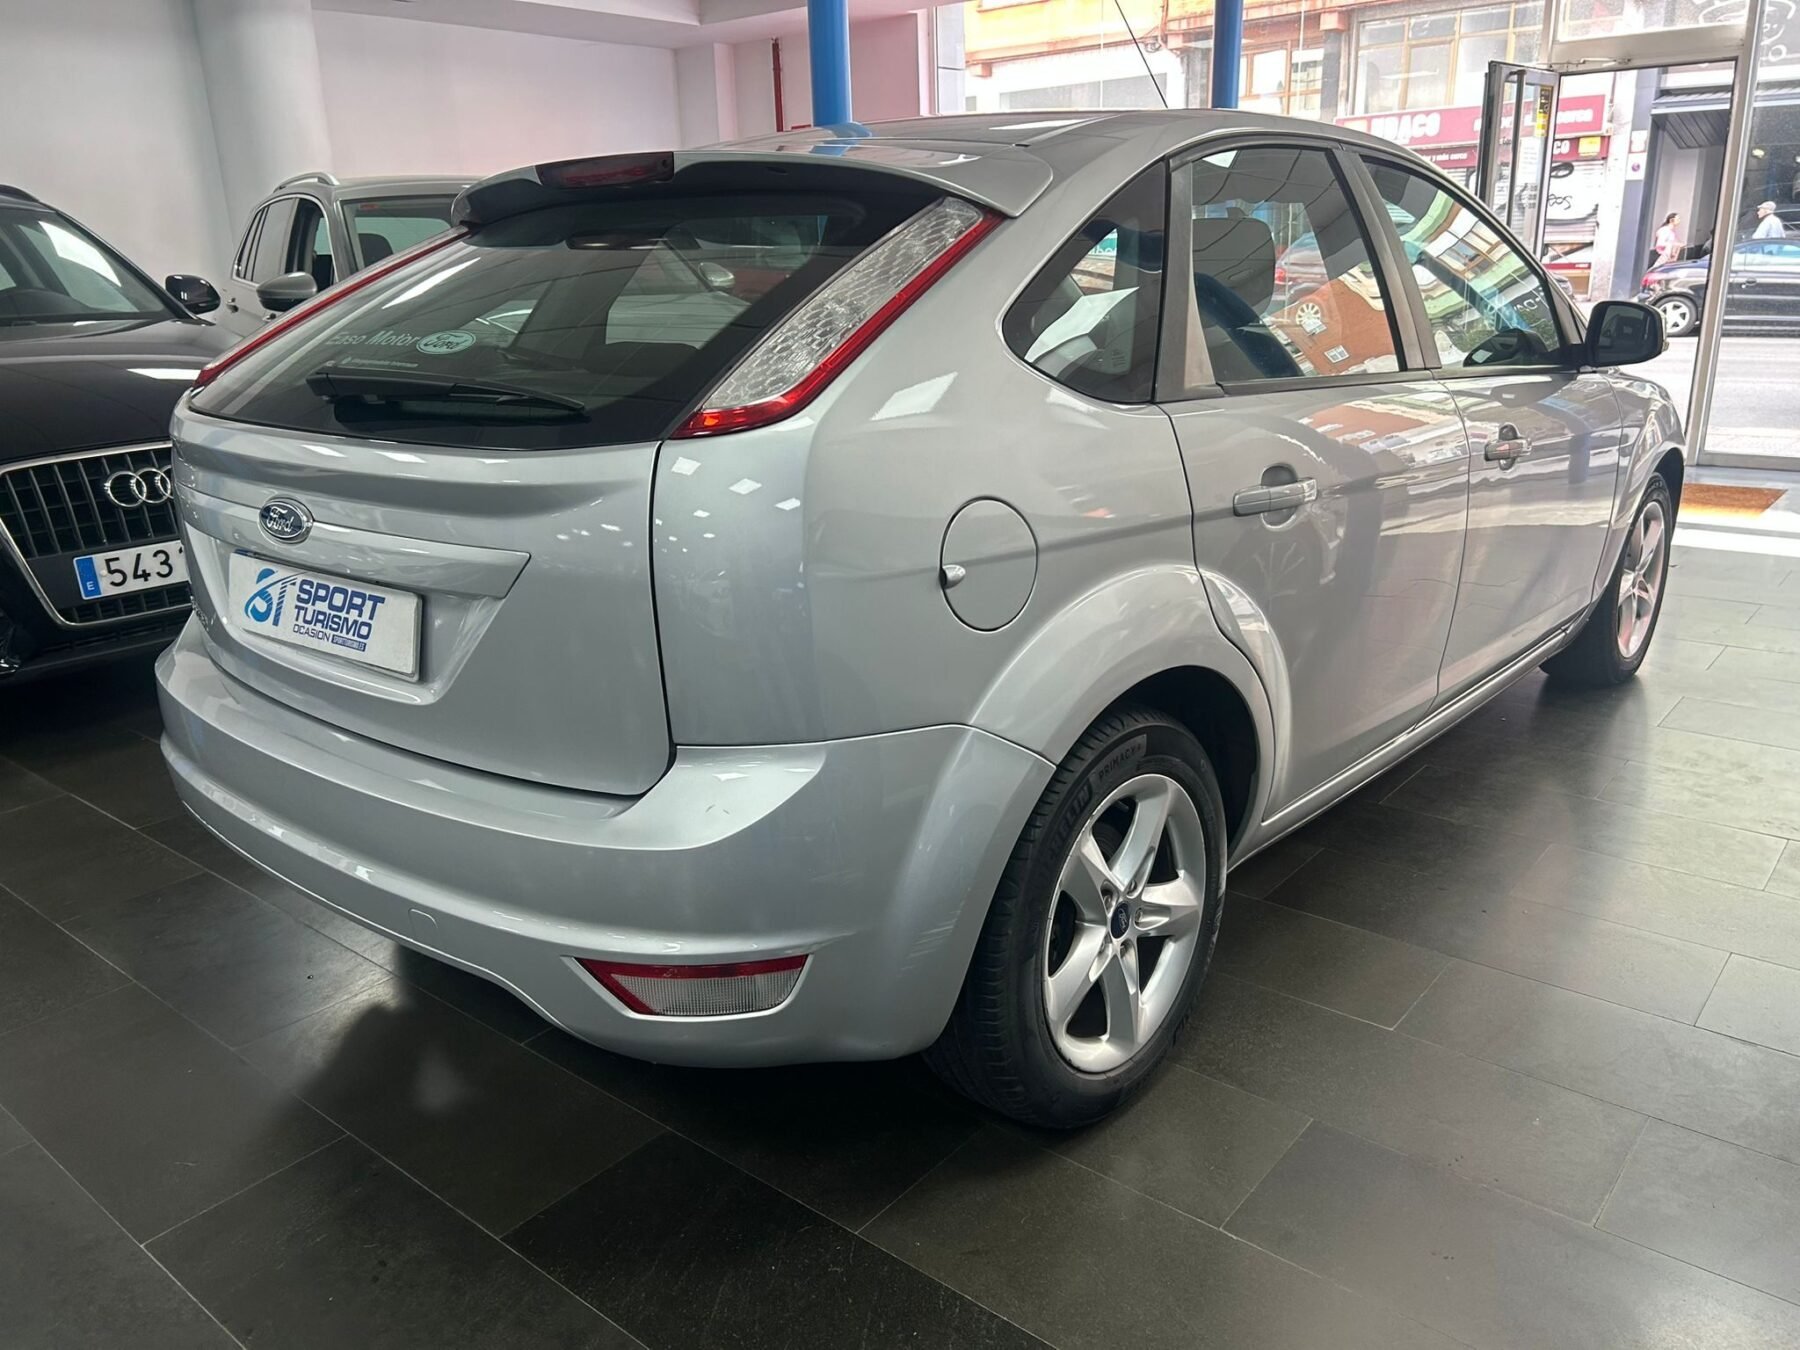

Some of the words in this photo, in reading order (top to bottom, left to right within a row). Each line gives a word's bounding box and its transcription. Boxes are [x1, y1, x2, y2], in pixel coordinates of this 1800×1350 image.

[366, 330, 421, 347] Motor
[423, 333, 467, 352] Ford
[104, 546, 184, 588] 543
[86, 581, 95, 591] E
[296, 578, 386, 621] SPORT
[292, 623, 331, 642] OCASION
[294, 605, 375, 641] TURISMO
[1098, 744, 1136, 782] PRIMACY
